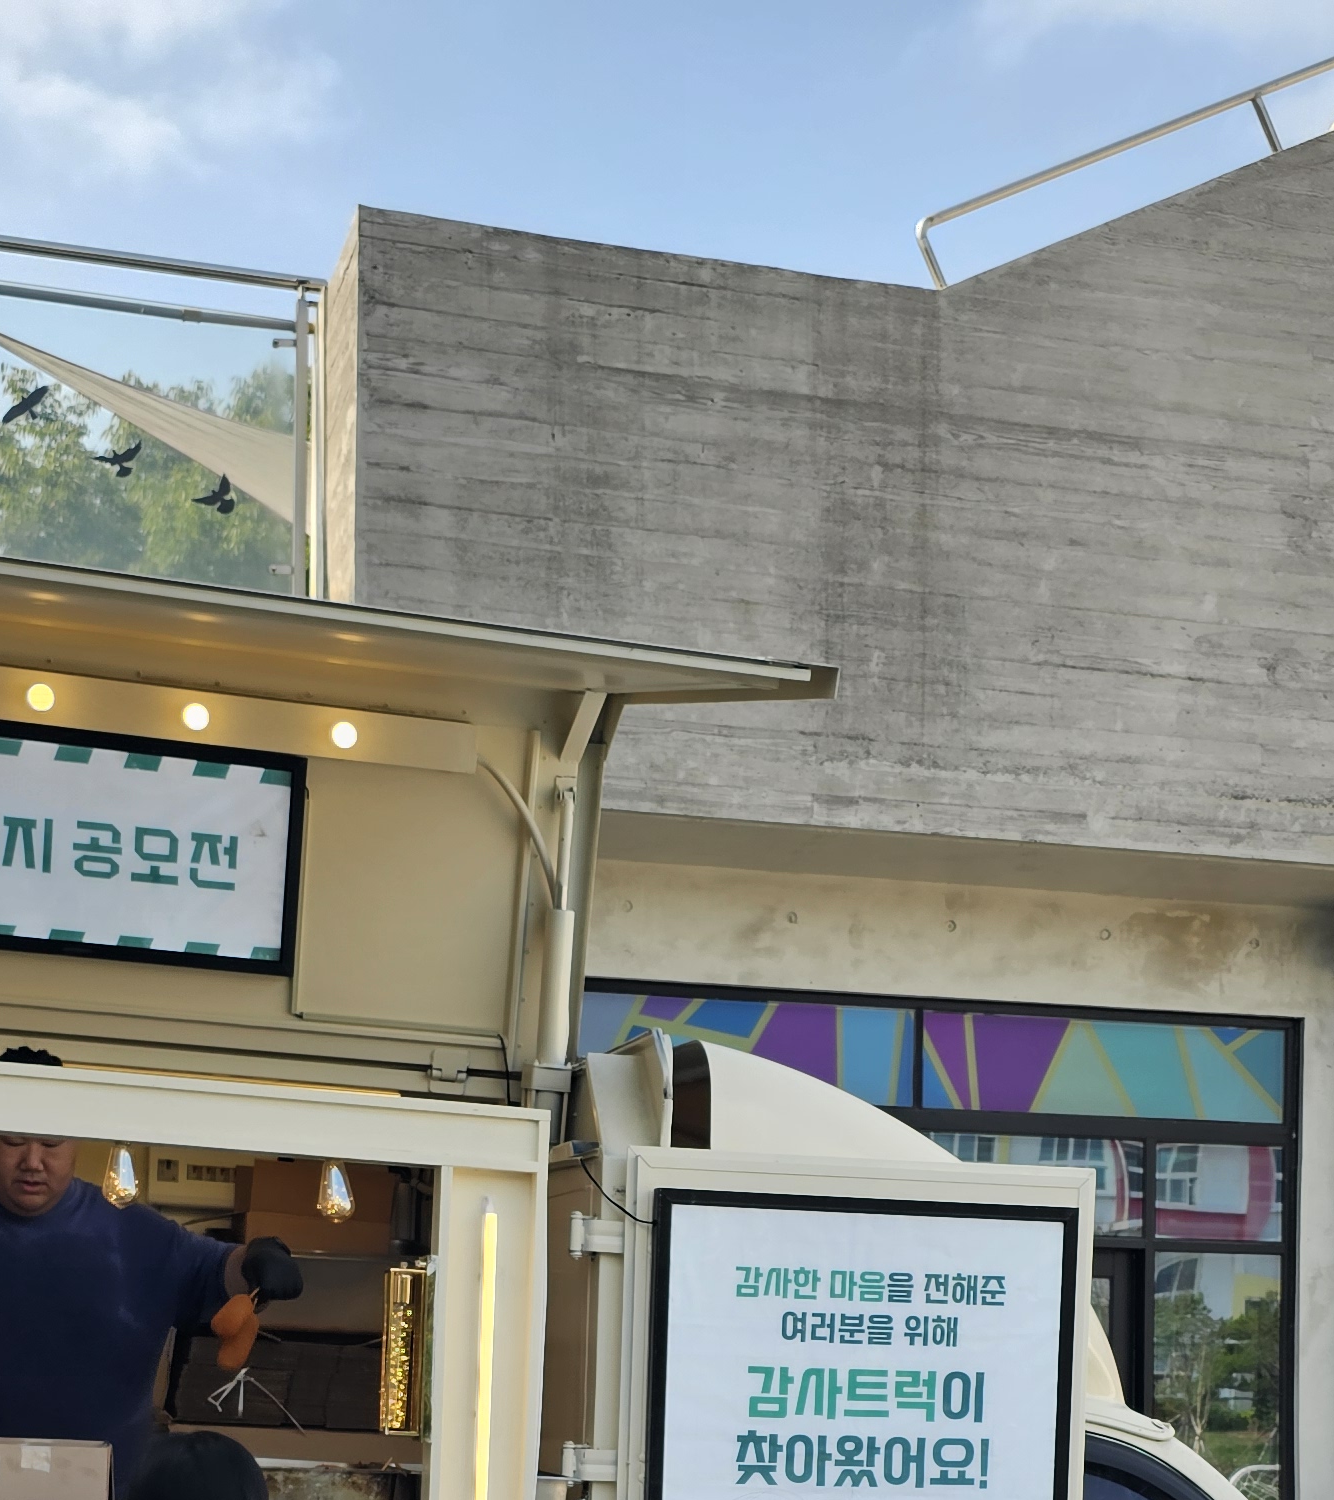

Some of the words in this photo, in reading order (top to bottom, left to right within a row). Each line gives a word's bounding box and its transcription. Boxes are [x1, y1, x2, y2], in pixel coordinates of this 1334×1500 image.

[72, 819, 240, 892] 공모전
[735, 1265, 822, 1301] 감사한
[829, 1269, 915, 1304] 마음을
[923, 1272, 1007, 1307] 전해준
[781, 1311, 894, 1346] 여러분을
[903, 1314, 959, 1348] 위해
[747, 1365, 986, 1424] 감사트럭이
[735, 1429, 990, 1490] 찾아왔어요!
